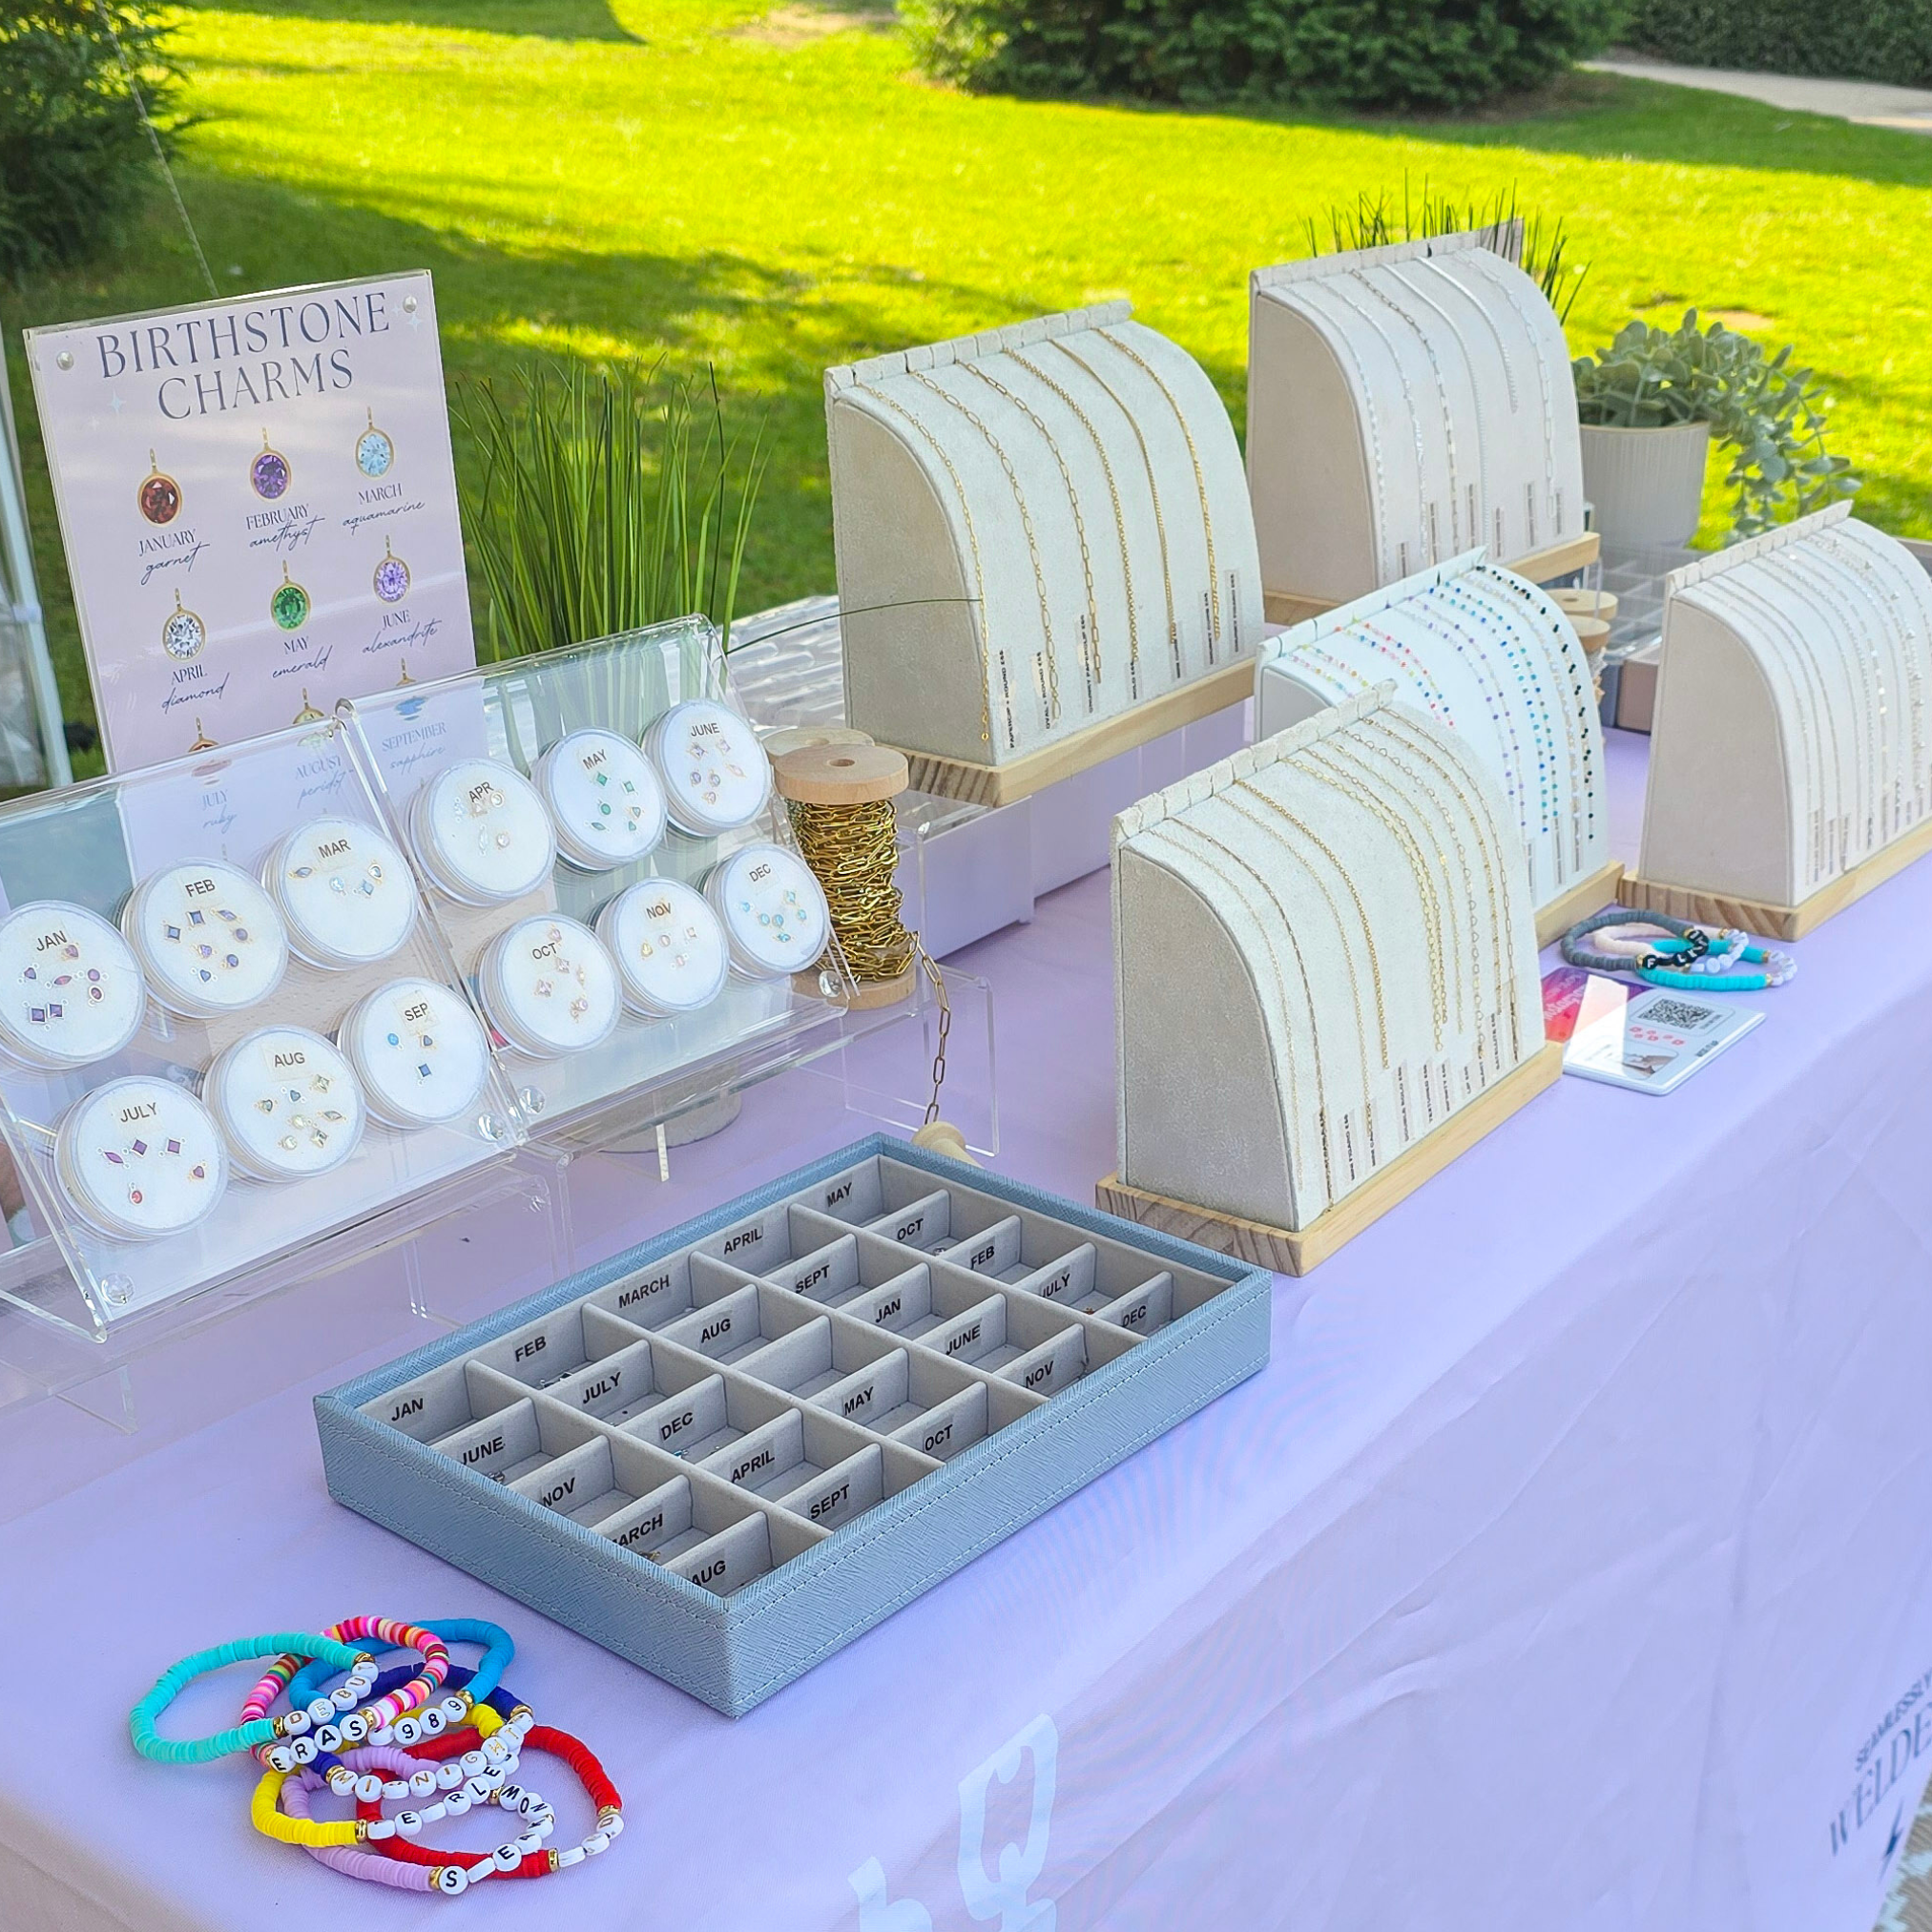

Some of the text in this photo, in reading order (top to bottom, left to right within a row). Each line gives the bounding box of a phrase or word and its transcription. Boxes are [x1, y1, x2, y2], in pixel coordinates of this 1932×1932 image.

[96, 292, 389, 379] BIRTHSTONE
[158, 348, 353, 420] CHARMS
[358, 483, 403, 505] MARCH
[245, 503, 310, 530] FEBRUARY
[343, 501, 426, 534] aquamarine
[138, 528, 197, 556] JANUARY
[249, 518, 324, 552] amethyst
[140, 544, 210, 585] garnet
[382, 610, 410, 631] JUNE
[283, 636, 310, 654] MAY
[362, 620, 442, 654] alexandrite
[171, 664, 207, 686] APRIL
[272, 646, 333, 678] emerald
[161, 673, 229, 714] diamond
[382, 721, 447, 752] SEPTEMBER
[690, 722, 720, 737] JUNE
[295, 754, 342, 779] AUGUST
[389, 744, 447, 775] sapphire
[582, 749, 609, 770] MAY
[201, 789, 228, 811] JULY
[468, 781, 494, 802] APR
[202, 804, 238, 834] ruby
[318, 839, 351, 859] MAR
[749, 863, 772, 883] DEC
[184, 878, 217, 899] FEB
[646, 902, 673, 920] NOV
[35, 930, 68, 952] JAN
[531, 943, 557, 962] OCT
[404, 1002, 429, 1023] SEP
[273, 1050, 306, 1068] AUG
[119, 1102, 158, 1123] JULY
[826, 1182, 853, 1208] MAY
[723, 1228, 762, 1255] APRIL
[896, 1218, 924, 1240] OCT
[969, 1245, 996, 1270] FEB
[618, 1275, 670, 1308] MARCH
[795, 1264, 831, 1295] SEPT
[875, 1298, 902, 1324] JAN
[1122, 1305, 1147, 1327] DEC
[700, 1319, 732, 1343] AUG
[945, 1324, 982, 1356] JUNE
[514, 1336, 547, 1362] FEB
[582, 1372, 622, 1404] JULY
[1025, 1361, 1054, 1388] NOV
[391, 1398, 425, 1422] JAN
[843, 1386, 875, 1418] MAY
[660, 1412, 694, 1441] DEC
[924, 1423, 953, 1451] OCT
[461, 1436, 504, 1466] JUNE
[731, 1450, 776, 1484] APRIL
[542, 1477, 575, 1508] NOV
[809, 1484, 851, 1520] SEPT
[613, 1513, 663, 1547] ARCH
[691, 1560, 726, 1587] AUG
[373, 1700, 461, 1738] 989
[272, 1720, 363, 1772] ERAS
